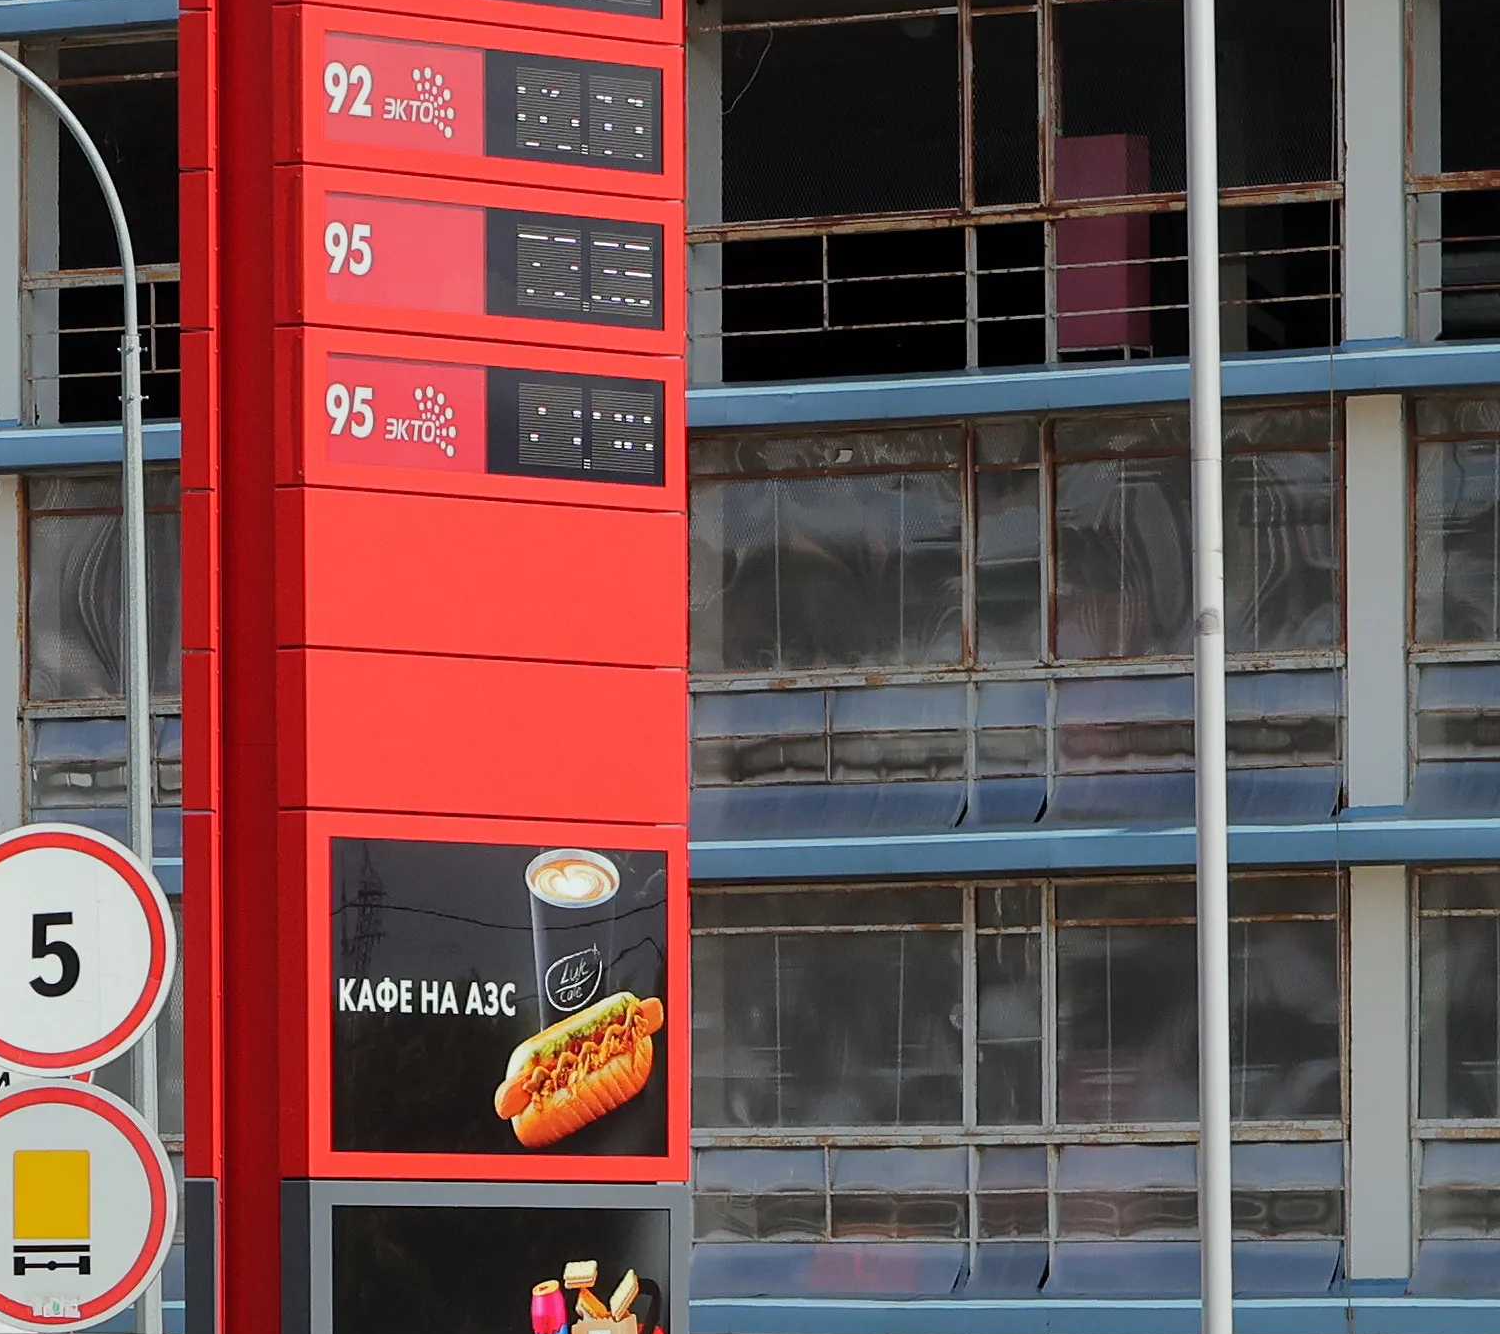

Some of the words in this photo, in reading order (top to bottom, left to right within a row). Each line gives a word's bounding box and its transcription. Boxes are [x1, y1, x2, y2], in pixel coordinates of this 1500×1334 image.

[323, 61, 373, 118] 92
[383, 96, 435, 124] ЭКТО
[324, 221, 373, 276] 95
[325, 382, 375, 439] 95
[384, 417, 436, 443] ЭКТО
[29, 911, 80, 998] 5
[338, 976, 413, 1014] КАФЕ
[420, 980, 459, 1015] НА
[464, 981, 516, 1017] АЗС
